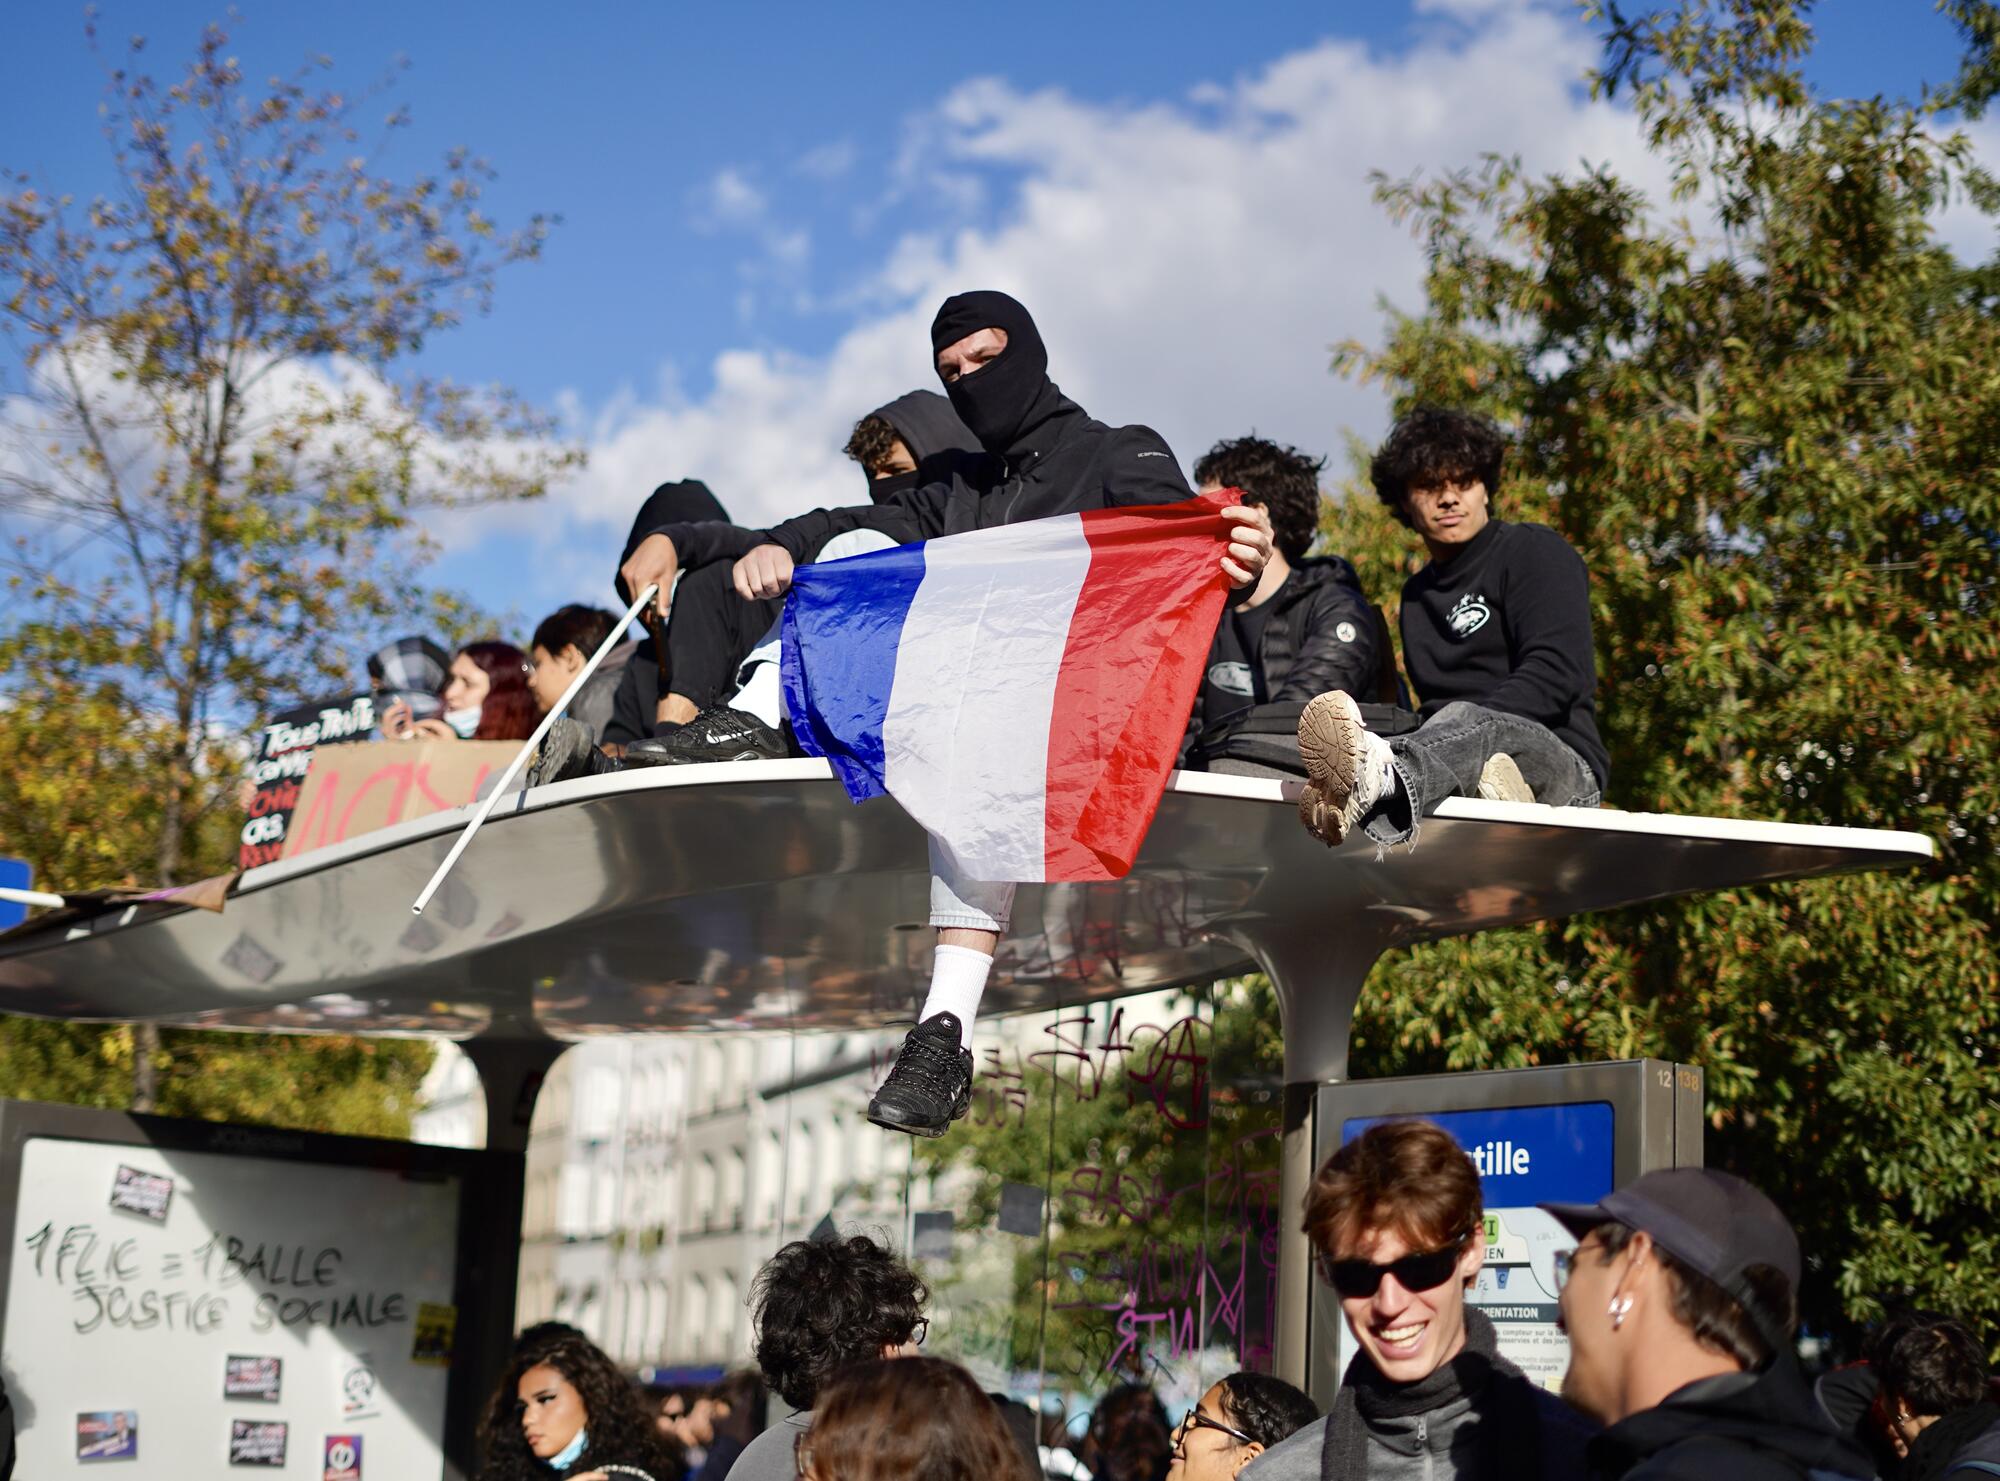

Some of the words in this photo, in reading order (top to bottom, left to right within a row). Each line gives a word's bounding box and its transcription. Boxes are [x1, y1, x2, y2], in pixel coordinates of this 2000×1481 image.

[1657, 1070, 1671, 1088] 12
[1465, 1140, 1530, 1176] tille
[218, 1235, 343, 1290] BALLE
[250, 1292, 409, 1335] SOCIALE
[1478, 1307, 1538, 1319] MENTATION
